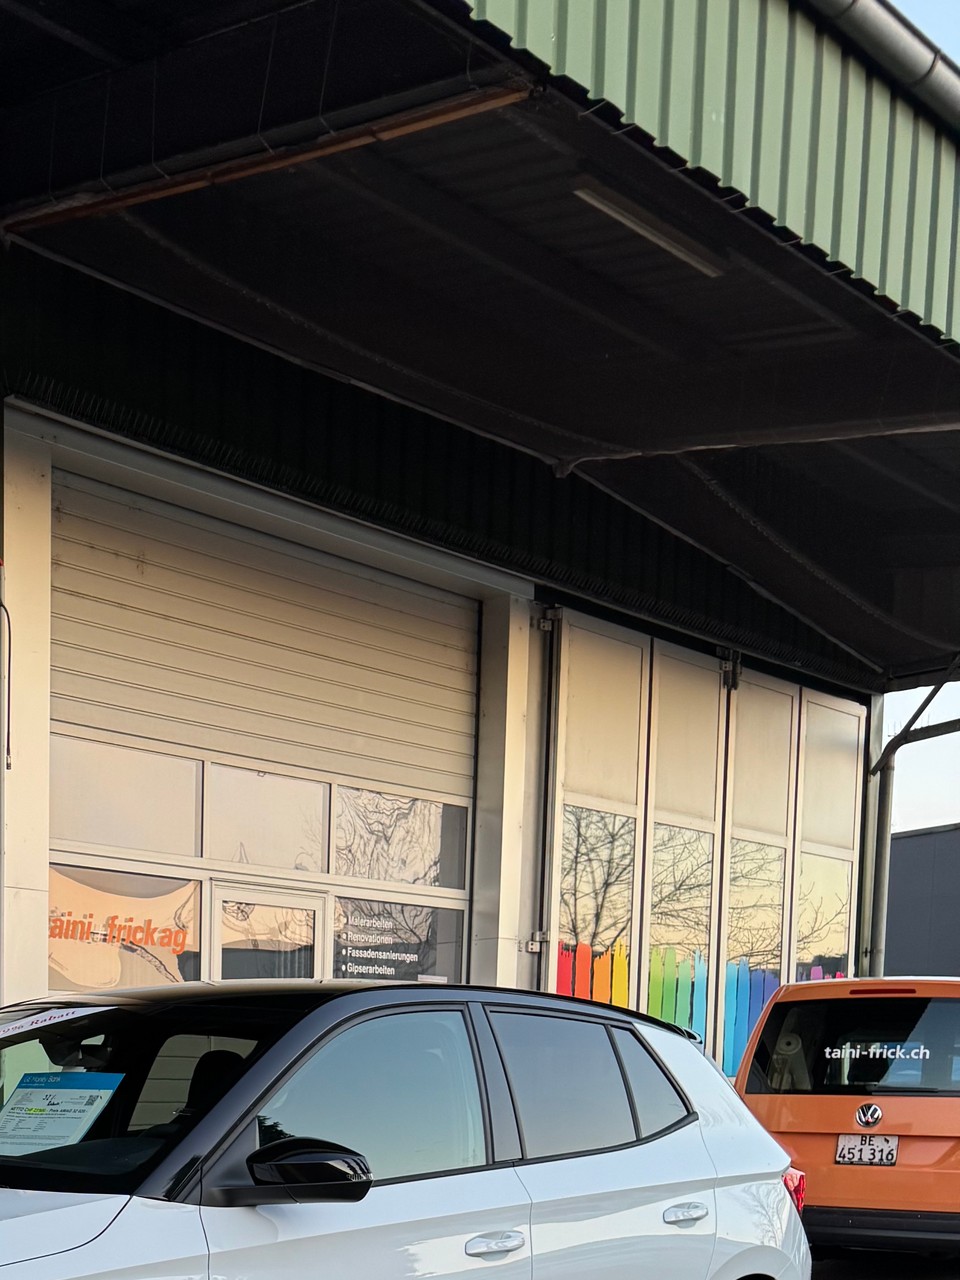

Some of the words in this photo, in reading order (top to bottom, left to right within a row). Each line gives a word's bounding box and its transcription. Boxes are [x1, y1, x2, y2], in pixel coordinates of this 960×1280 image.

[49, 911, 94, 941] aini
[348, 917, 393, 929] Malerarbeiten
[347, 932, 393, 945] Renovationen
[347, 947, 419, 963] Fassadensanierungen
[347, 963, 395, 976] Gipserarbeiten
[824, 1045, 930, 1060] taini-frick.ch
[860, 1136, 875, 1146] BE
